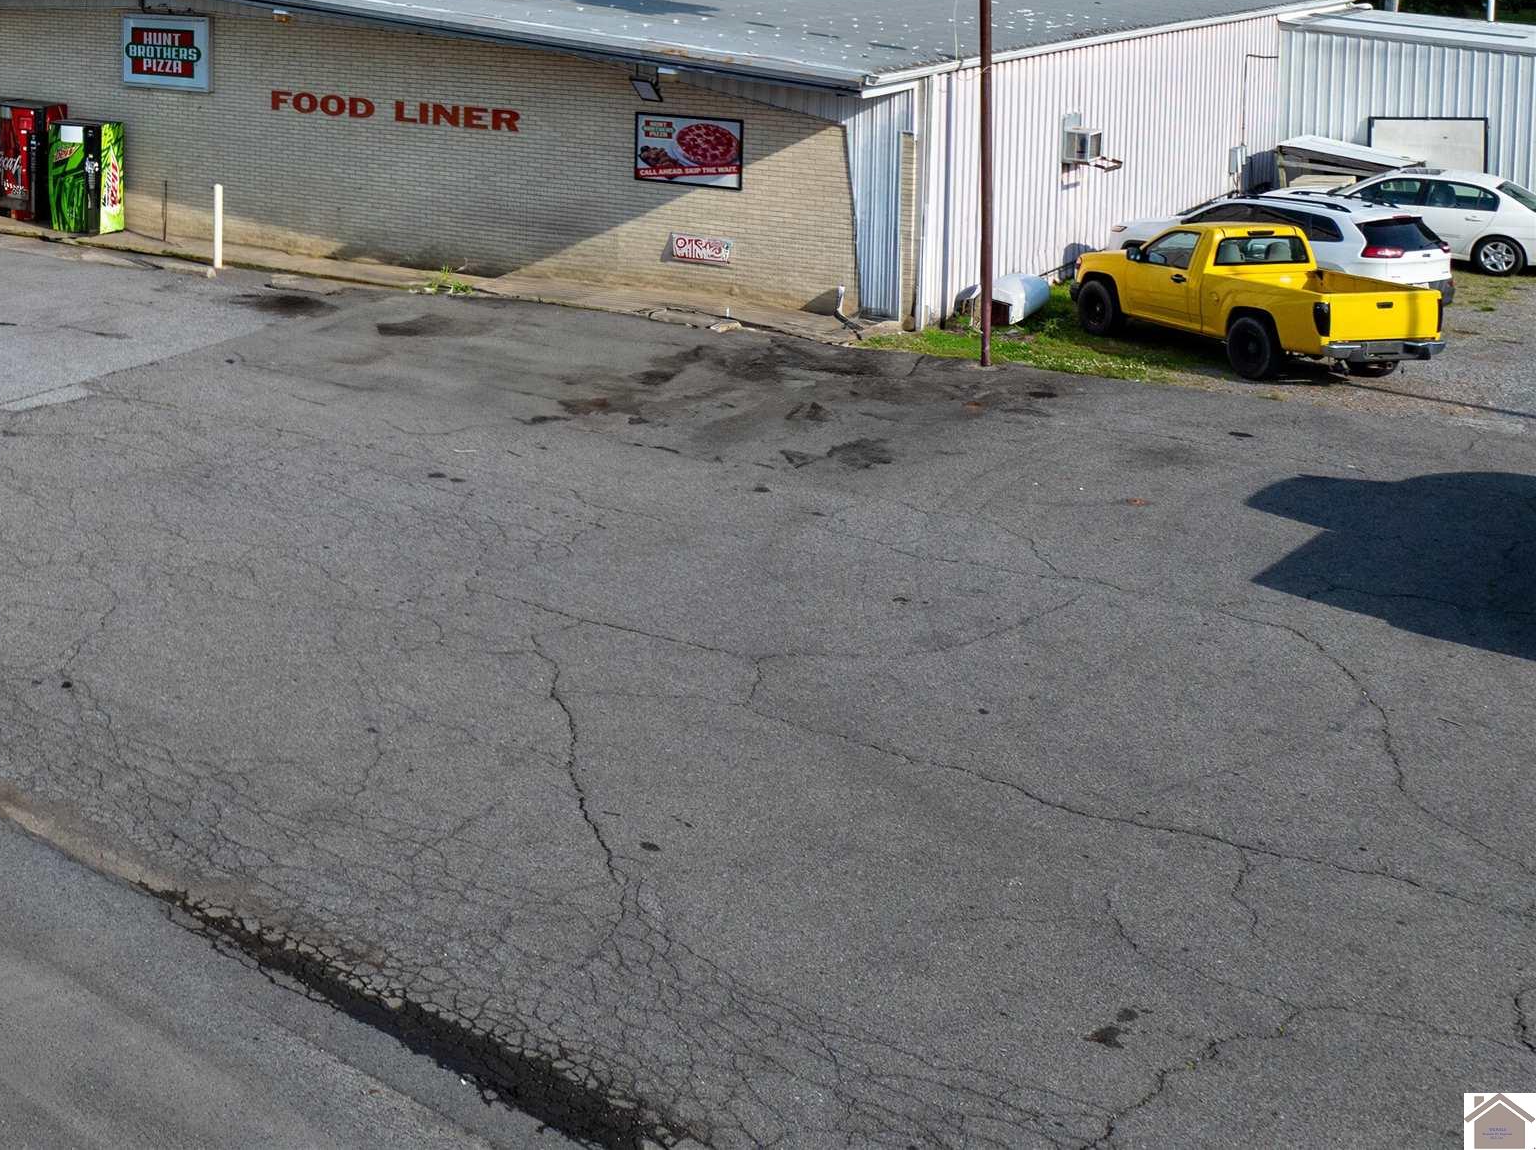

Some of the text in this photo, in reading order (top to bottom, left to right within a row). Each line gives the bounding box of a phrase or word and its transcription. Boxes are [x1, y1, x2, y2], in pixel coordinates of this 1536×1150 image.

[143, 31, 181, 46] HUNT
[128, 44, 198, 61] BROTHERS
[143, 59, 183, 74] PIZZA
[270, 89, 521, 133] FOOD LINER
